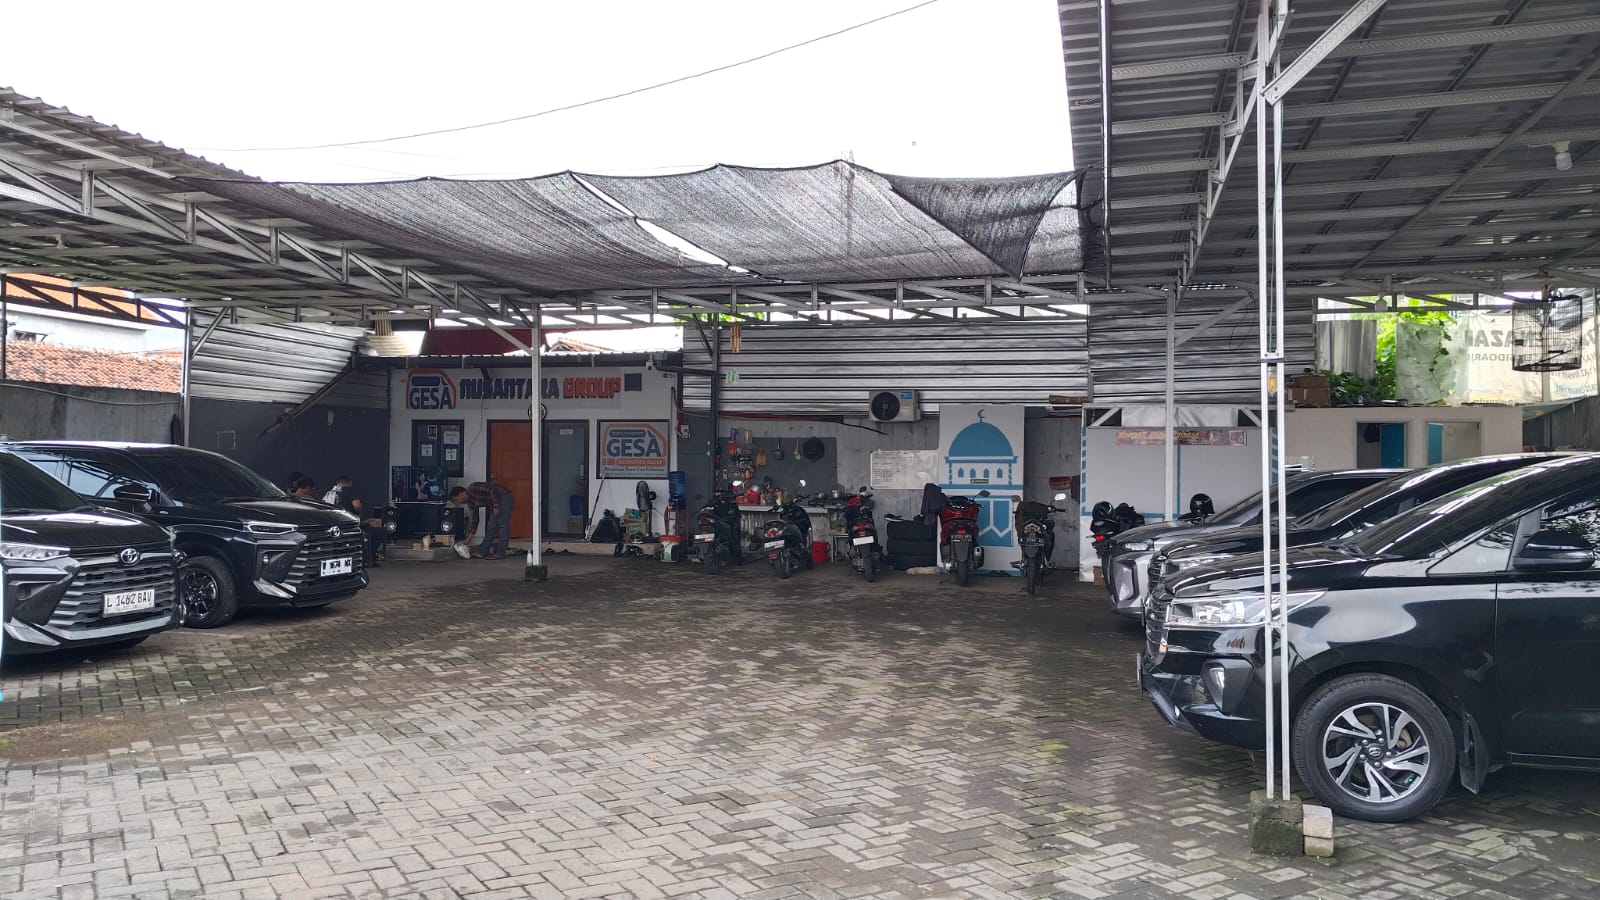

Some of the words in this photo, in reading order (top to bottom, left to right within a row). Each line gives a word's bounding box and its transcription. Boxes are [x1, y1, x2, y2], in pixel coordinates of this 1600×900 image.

[409, 387, 453, 410] GESA
[460, 378, 559, 399] NUSANTARA
[562, 377, 622, 399] GROUP
[607, 438, 661, 457] GESA
